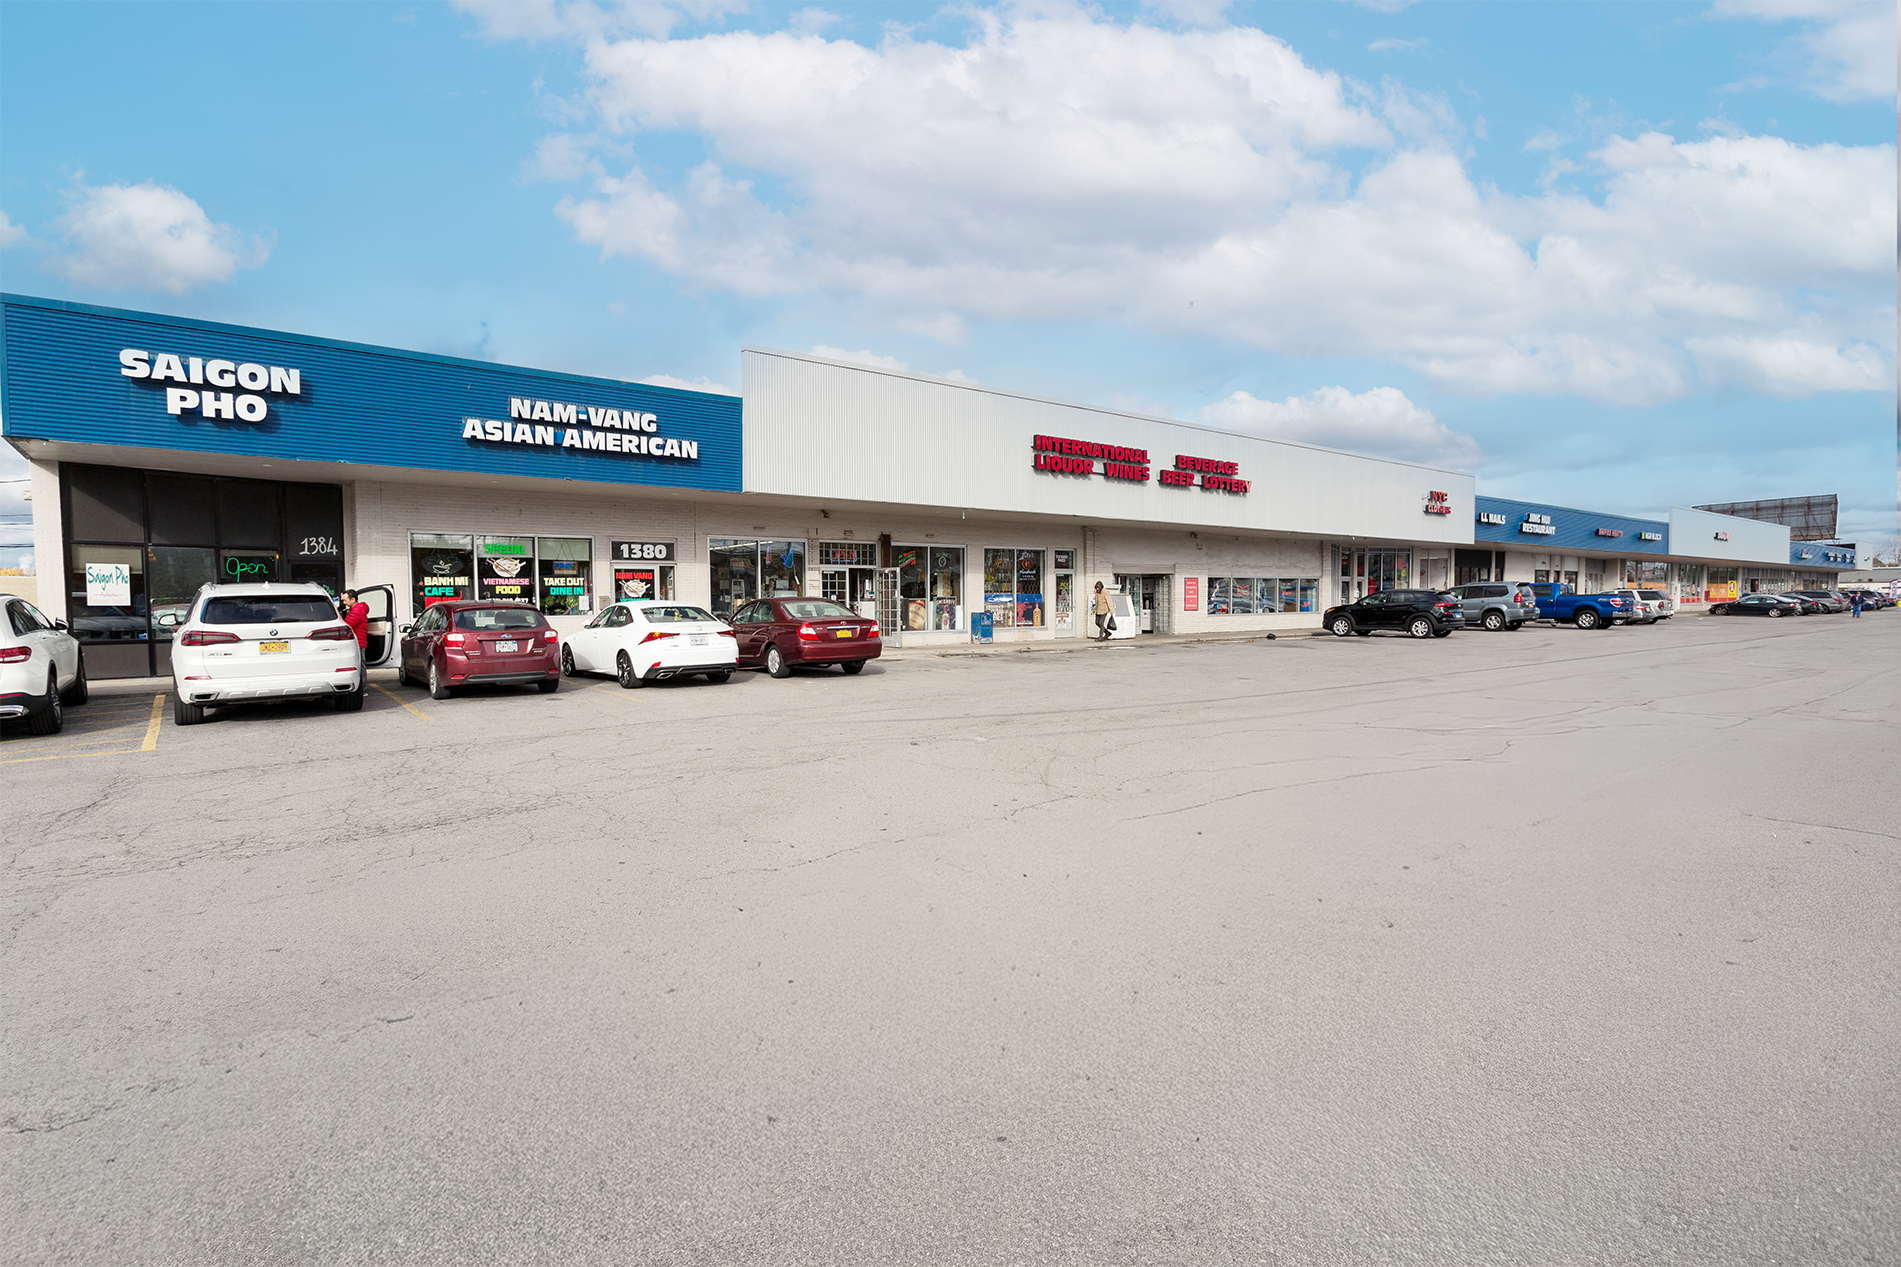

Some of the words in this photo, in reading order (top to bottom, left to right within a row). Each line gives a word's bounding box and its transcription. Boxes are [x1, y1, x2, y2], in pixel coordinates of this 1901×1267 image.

[119, 348, 300, 395] SAIGON
[166, 387, 267, 422] PHO
[511, 397, 657, 433] NAM-VANG
[462, 418, 554, 446] ASIAN
[562, 428, 698, 459] AMERICAN
[1034, 434, 1151, 464] INTERNATIONAL
[1035, 454, 1095, 475] LIQUOR
[1104, 462, 1150, 481] WINES
[1177, 455, 1239, 476] BEVERAGE
[1161, 470, 1195, 487] BEER
[1203, 474, 1252, 493] LOTTERY
[1432, 490, 1448, 503] NYC
[1488, 513, 1506, 525] NAILS
[1522, 523, 1556, 535] RESTAURANT
[300, 537, 338, 556] 1384
[484, 544, 526, 555] SPECIAL
[620, 543, 667, 559] 1380
[831, 549, 857, 562] OPEN
[87, 566, 114, 591] Saigon
[115, 565, 129, 585] Pho
[226, 557, 269, 583] Open
[615, 572, 633, 580] NAM
[633, 572, 653, 580] VANG
[424, 577, 453, 586] BANH
[454, 576, 469, 586] MI
[544, 577, 566, 586] TAKE
[566, 577, 585, 586] OUT
[424, 587, 454, 596] CAFE
[495, 585, 521, 594] FOOD
[550, 587, 573, 595] DINE
[573, 587, 584, 595] IN
